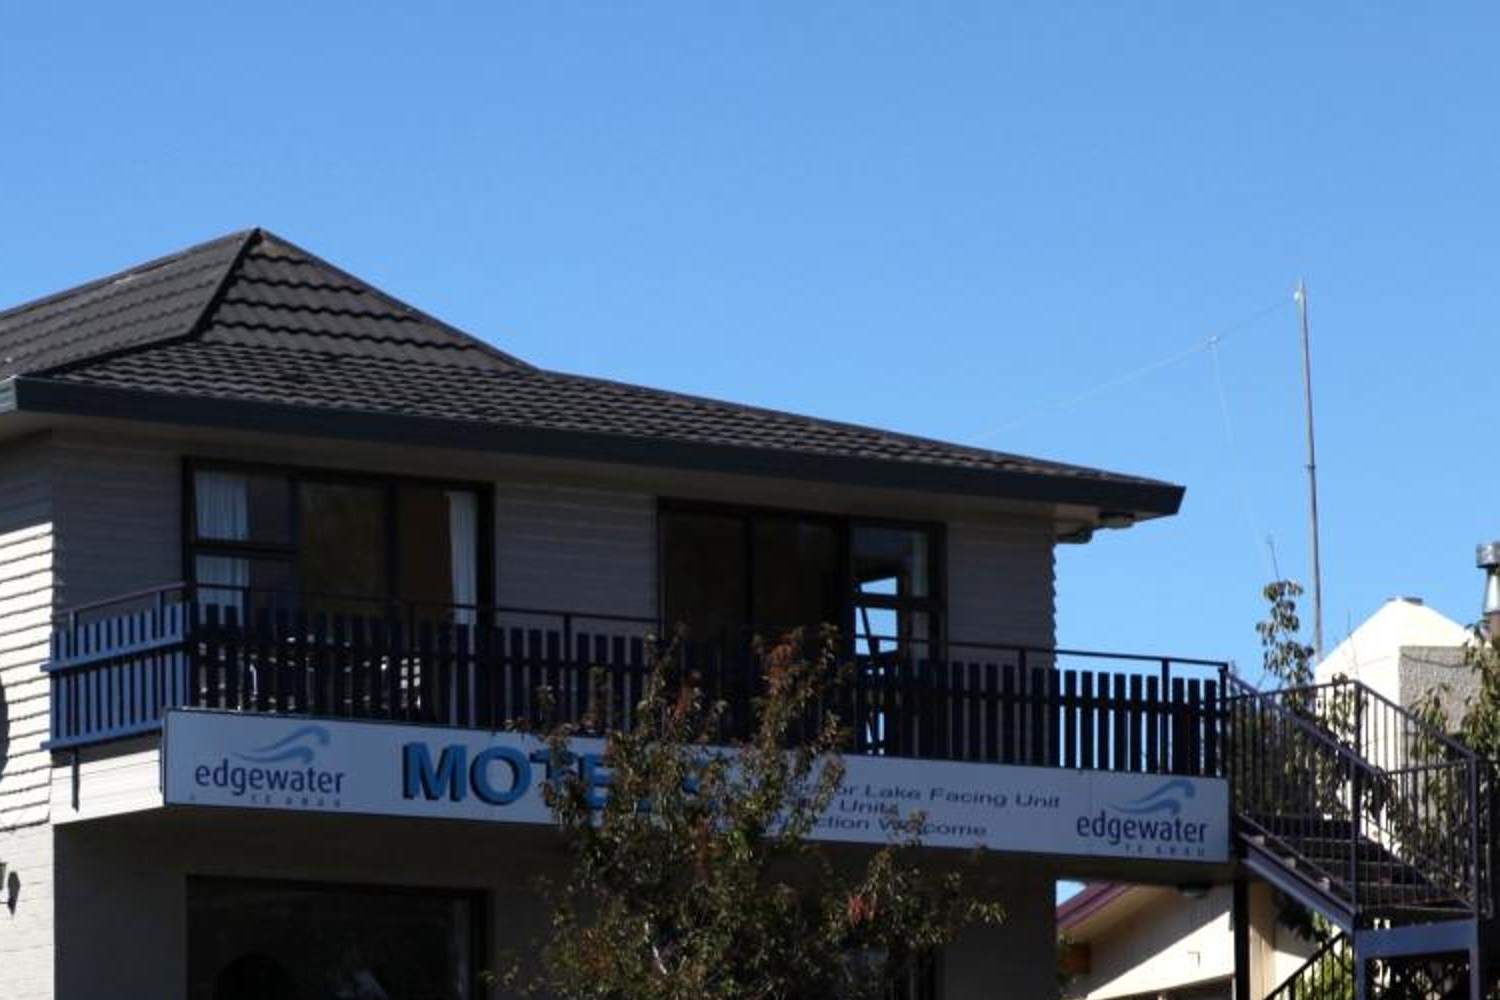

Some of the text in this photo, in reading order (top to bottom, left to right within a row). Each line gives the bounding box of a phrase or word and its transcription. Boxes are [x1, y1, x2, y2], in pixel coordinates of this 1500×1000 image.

[195, 756, 346, 796] edgewater
[865, 784, 921, 800] Lake
[930, 787, 1008, 808] Facing
[1015, 793, 1061, 808] Unit
[1076, 809, 1207, 845] edgewater
